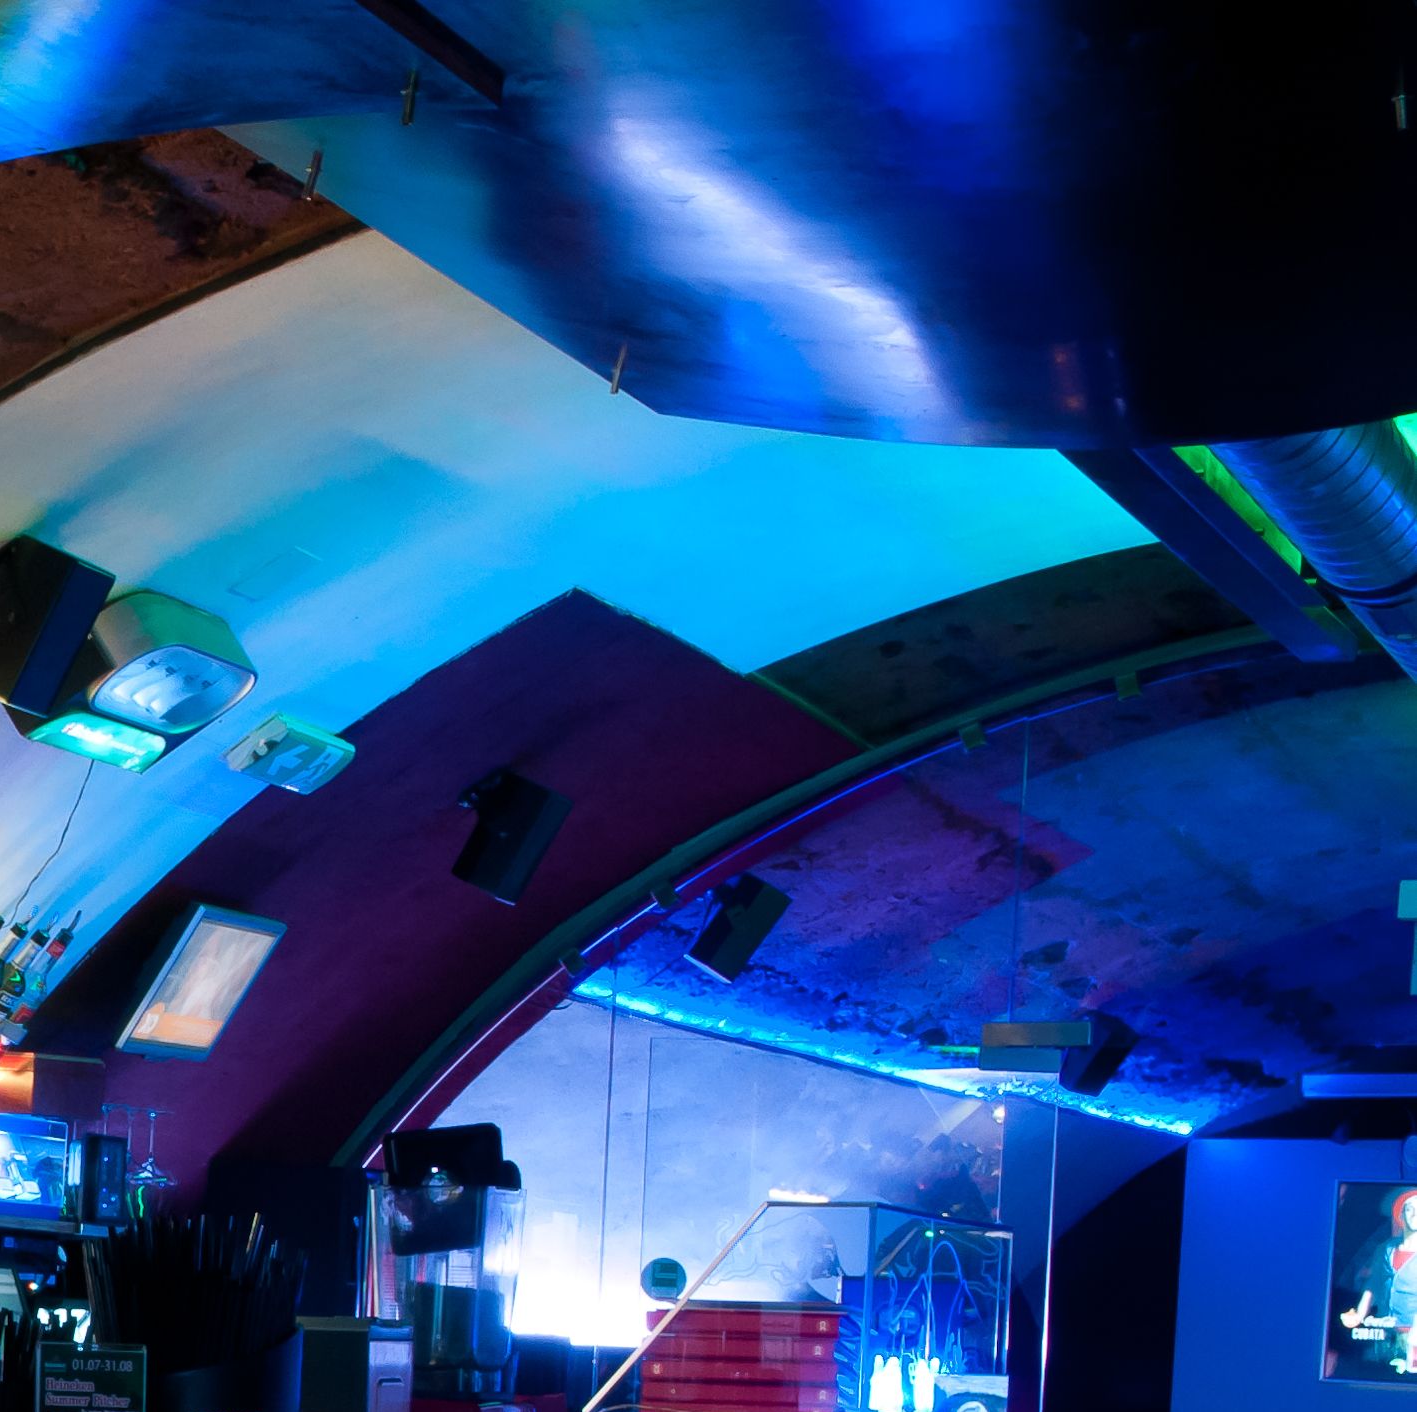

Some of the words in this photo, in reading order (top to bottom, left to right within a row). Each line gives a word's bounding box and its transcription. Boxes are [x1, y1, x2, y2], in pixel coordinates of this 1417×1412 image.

[71, 1358, 134, 1373] 01.07-31.08
[45, 1376, 96, 1392] Heineken
[45, 1392, 90, 1407] Summer
[91, 1393, 131, 1408] Pitcher
